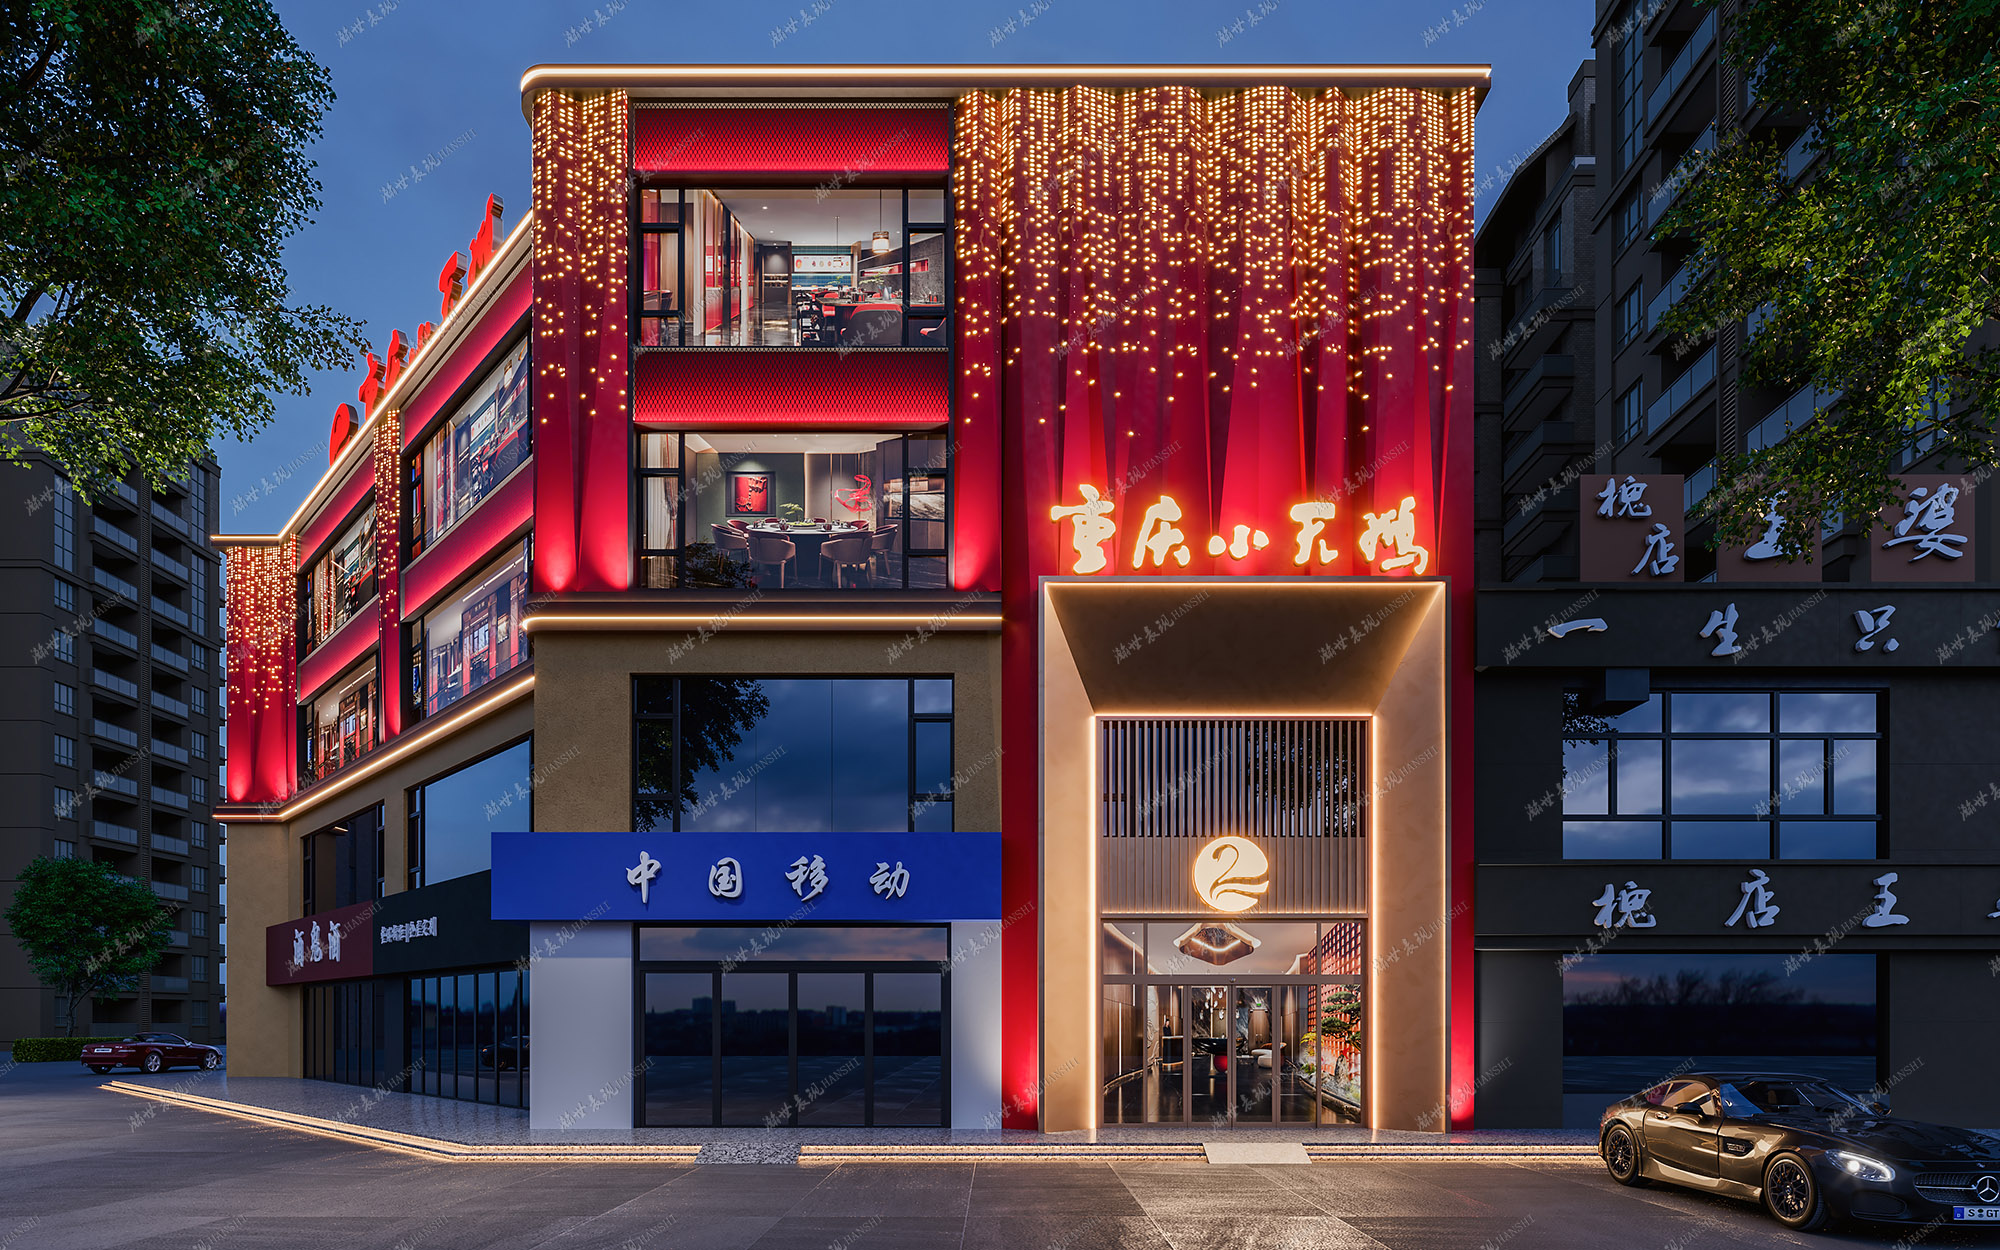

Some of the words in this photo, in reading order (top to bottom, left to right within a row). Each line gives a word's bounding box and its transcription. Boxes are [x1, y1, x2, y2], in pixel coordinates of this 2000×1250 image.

[1050, 484, 1428, 575] 重庆小天鹅
[1547, 602, 2000, 657] 一生只
[626, 850, 910, 904] 中国移动
[1592, 868, 2000, 928] 槐店王
